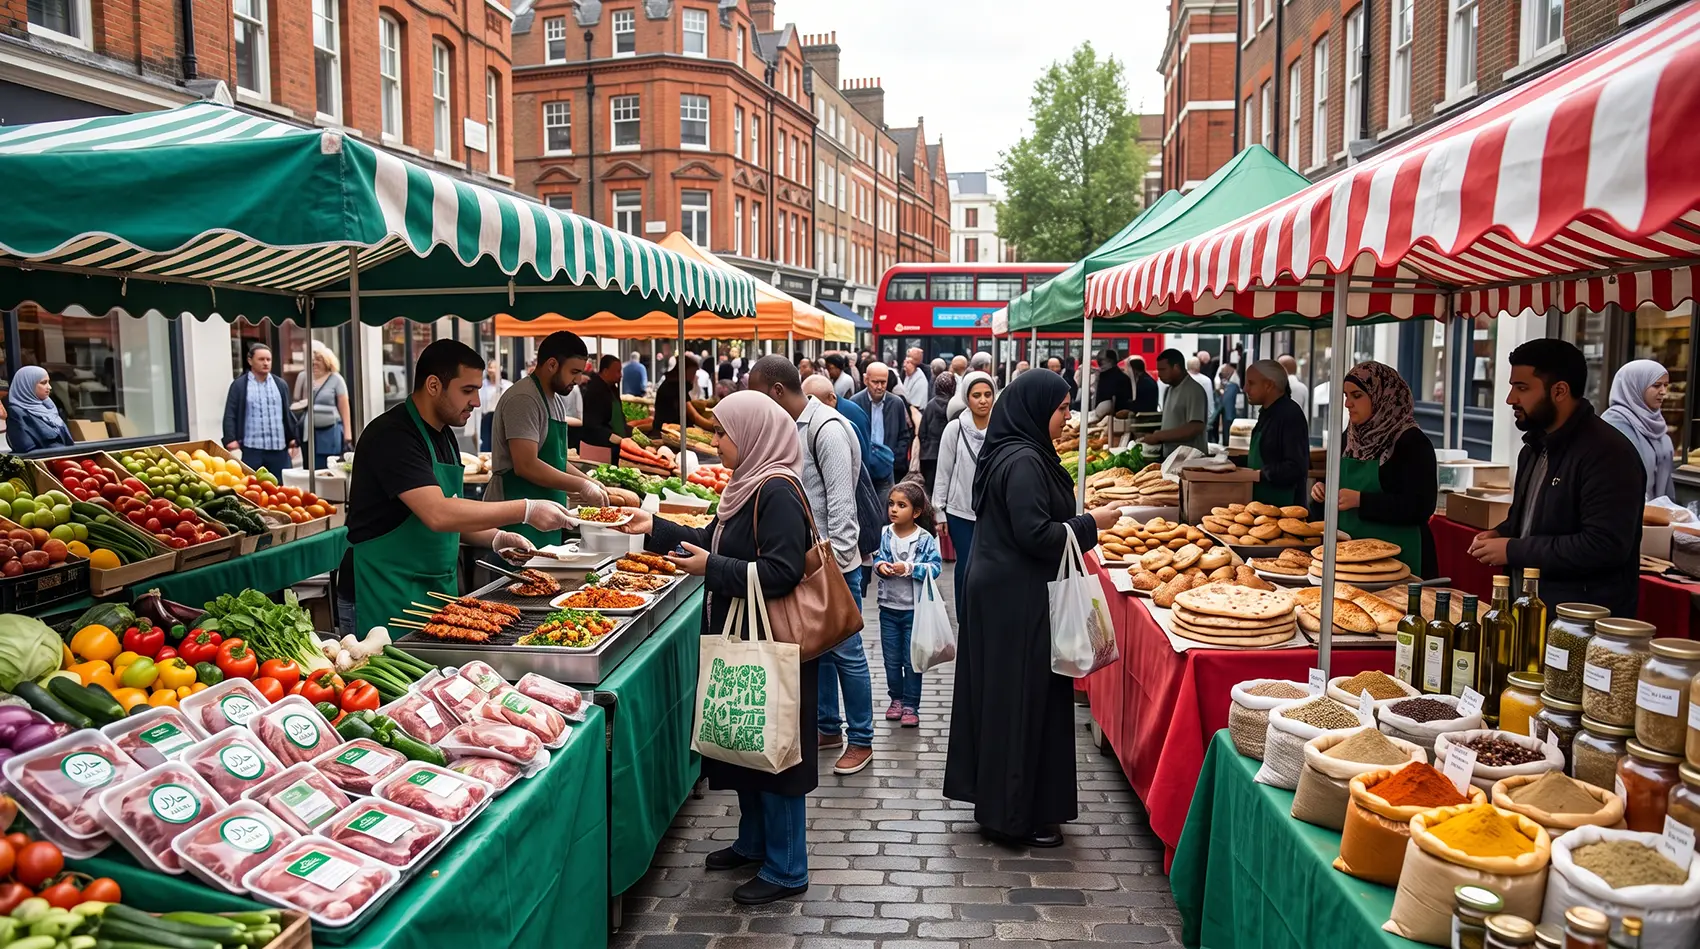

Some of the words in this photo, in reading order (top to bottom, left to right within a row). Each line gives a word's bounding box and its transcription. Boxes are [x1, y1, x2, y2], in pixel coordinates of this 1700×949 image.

[290, 722, 311, 736] حلال
[72, 760, 102, 775] حلال
[229, 753, 252, 767] حلال
[160, 793, 188, 810] حلال
[230, 823, 258, 841] حلال
